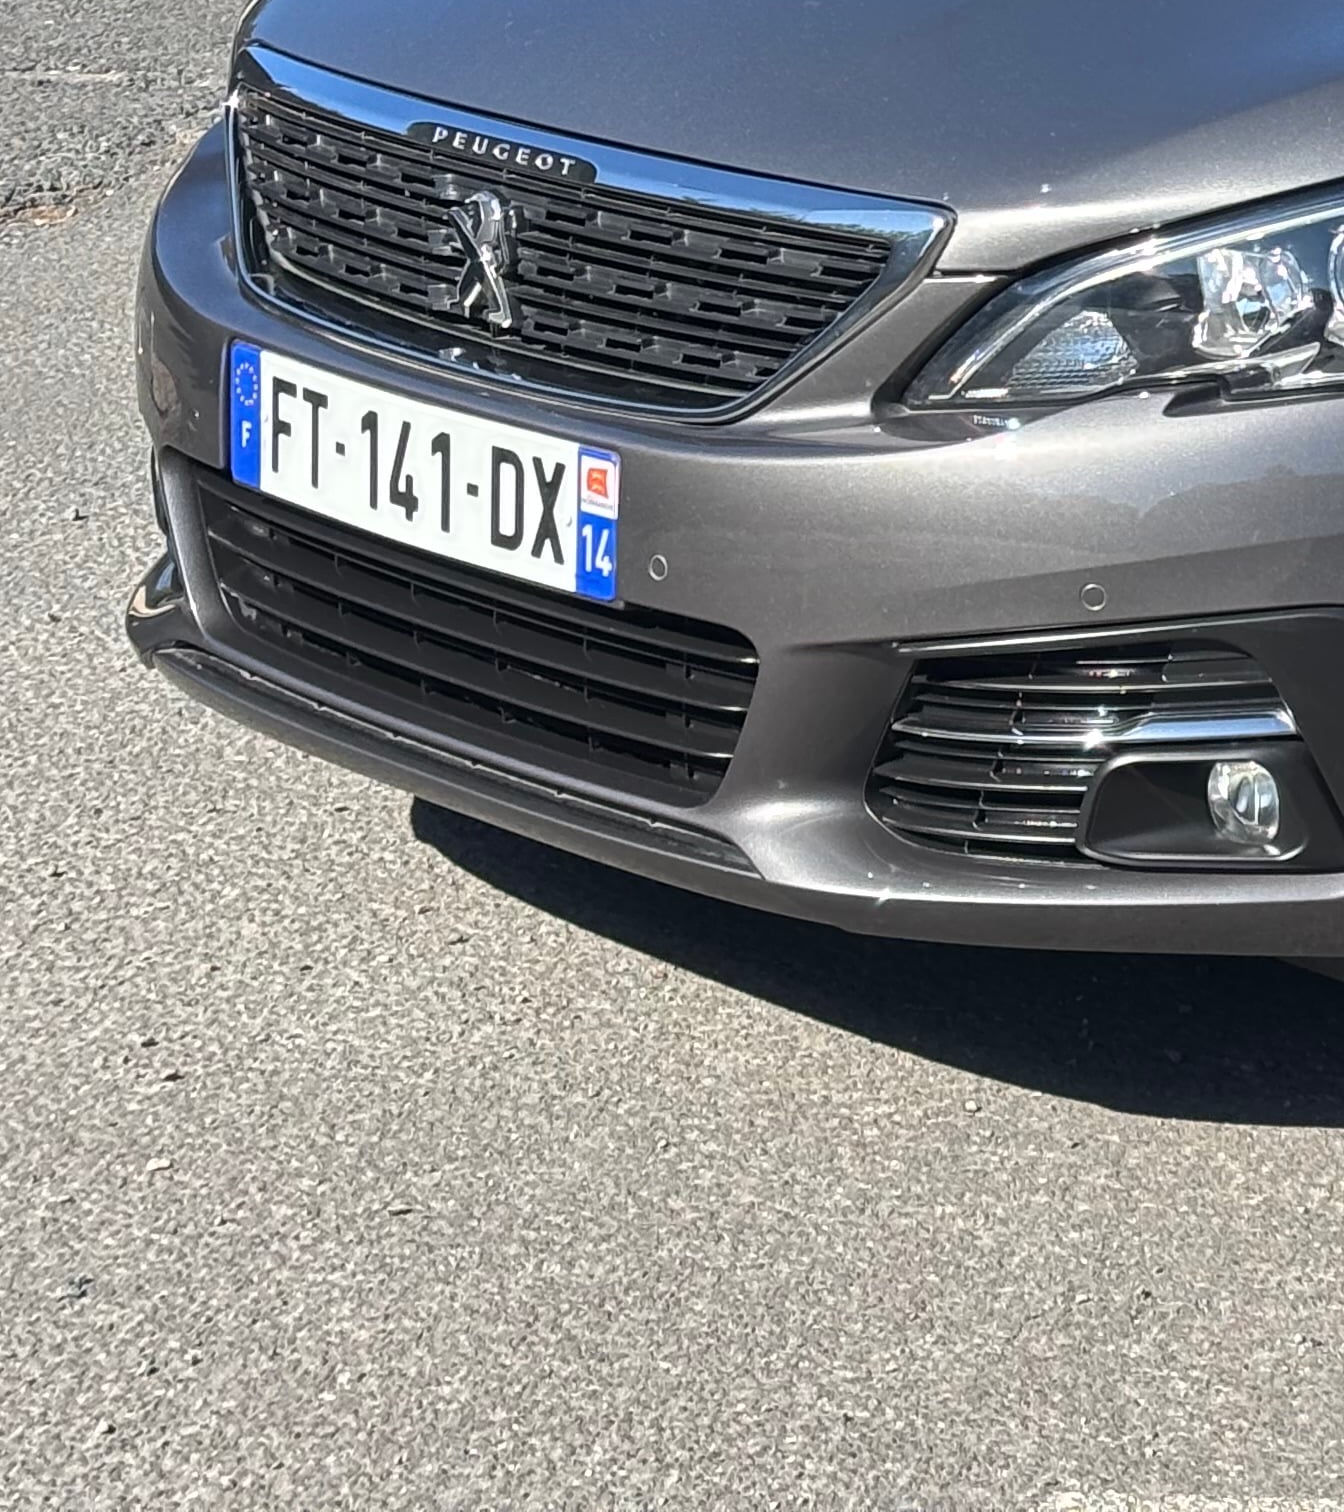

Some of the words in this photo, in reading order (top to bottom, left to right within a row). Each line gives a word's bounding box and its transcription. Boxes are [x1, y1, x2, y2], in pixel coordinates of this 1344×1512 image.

[432, 126, 576, 175] PEUGEOT
[241, 420, 252, 448] F
[272, 376, 567, 565] FT-141-DX
[582, 524, 613, 577] 14
